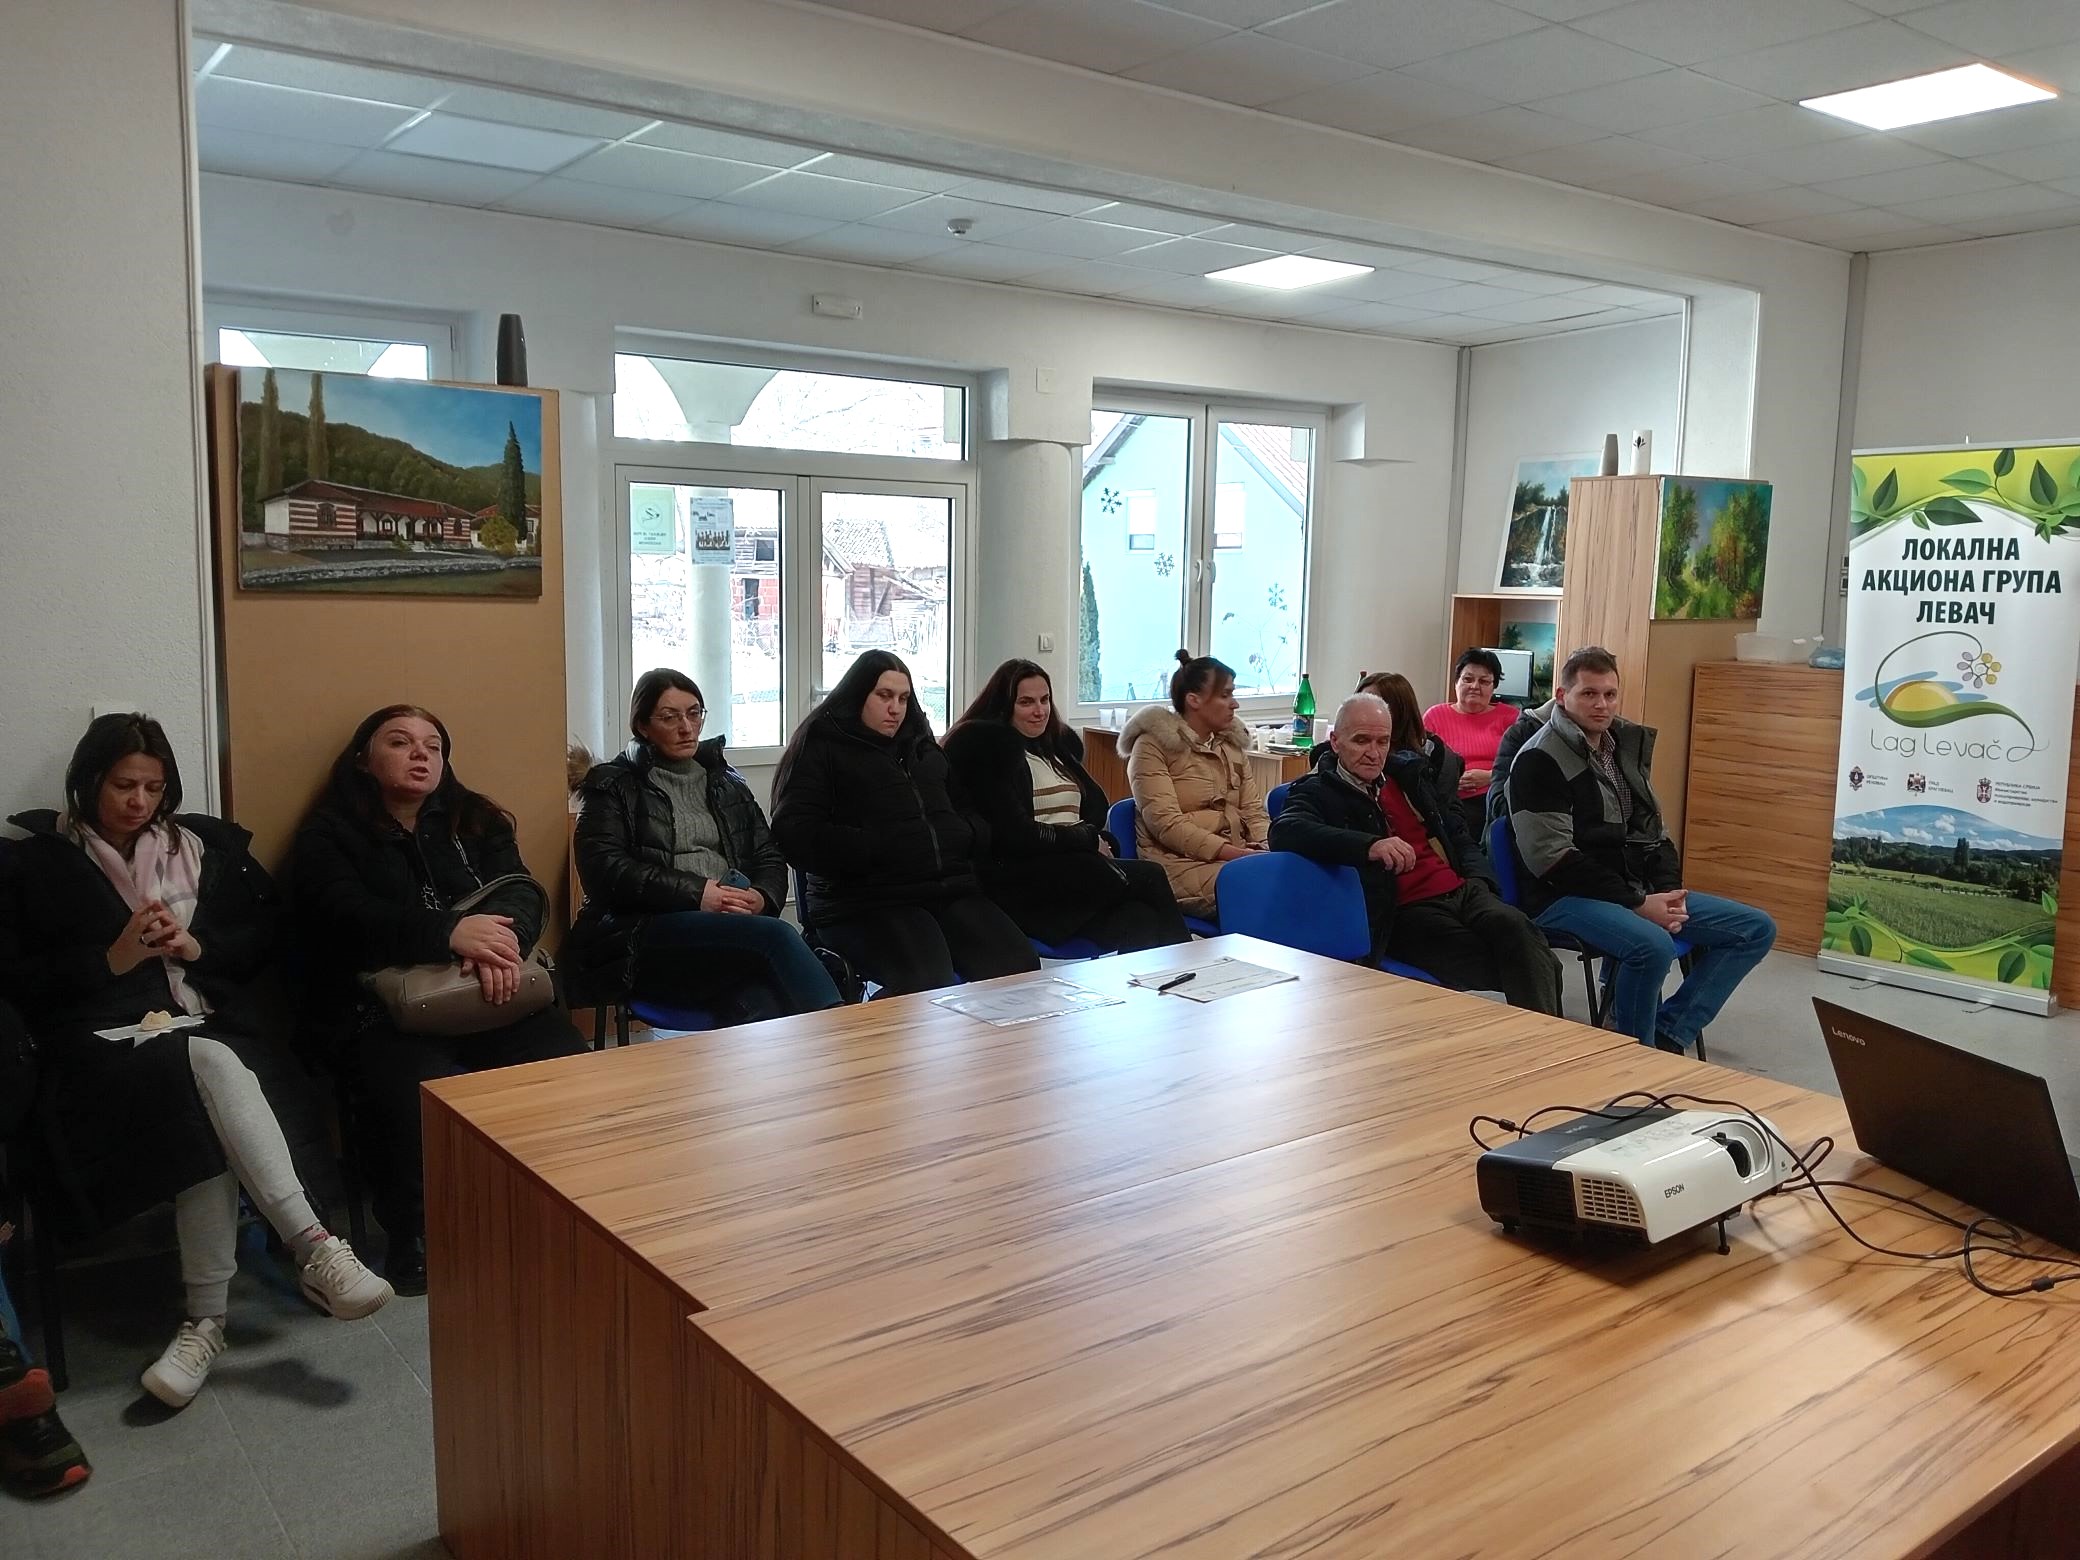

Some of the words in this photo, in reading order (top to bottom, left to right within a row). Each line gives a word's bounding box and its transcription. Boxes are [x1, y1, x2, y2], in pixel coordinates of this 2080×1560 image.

[1902, 538, 2020, 561] ЛОКАЛНА
[1861, 569, 1975, 596] АКЦИОНА
[1982, 570, 2062, 594] ГРУПА
[1916, 600, 1996, 625] ЛЕВАЧ
[1831, 1026, 1866, 1046] Lenovo
[1664, 1183, 1685, 1199] EPSON
